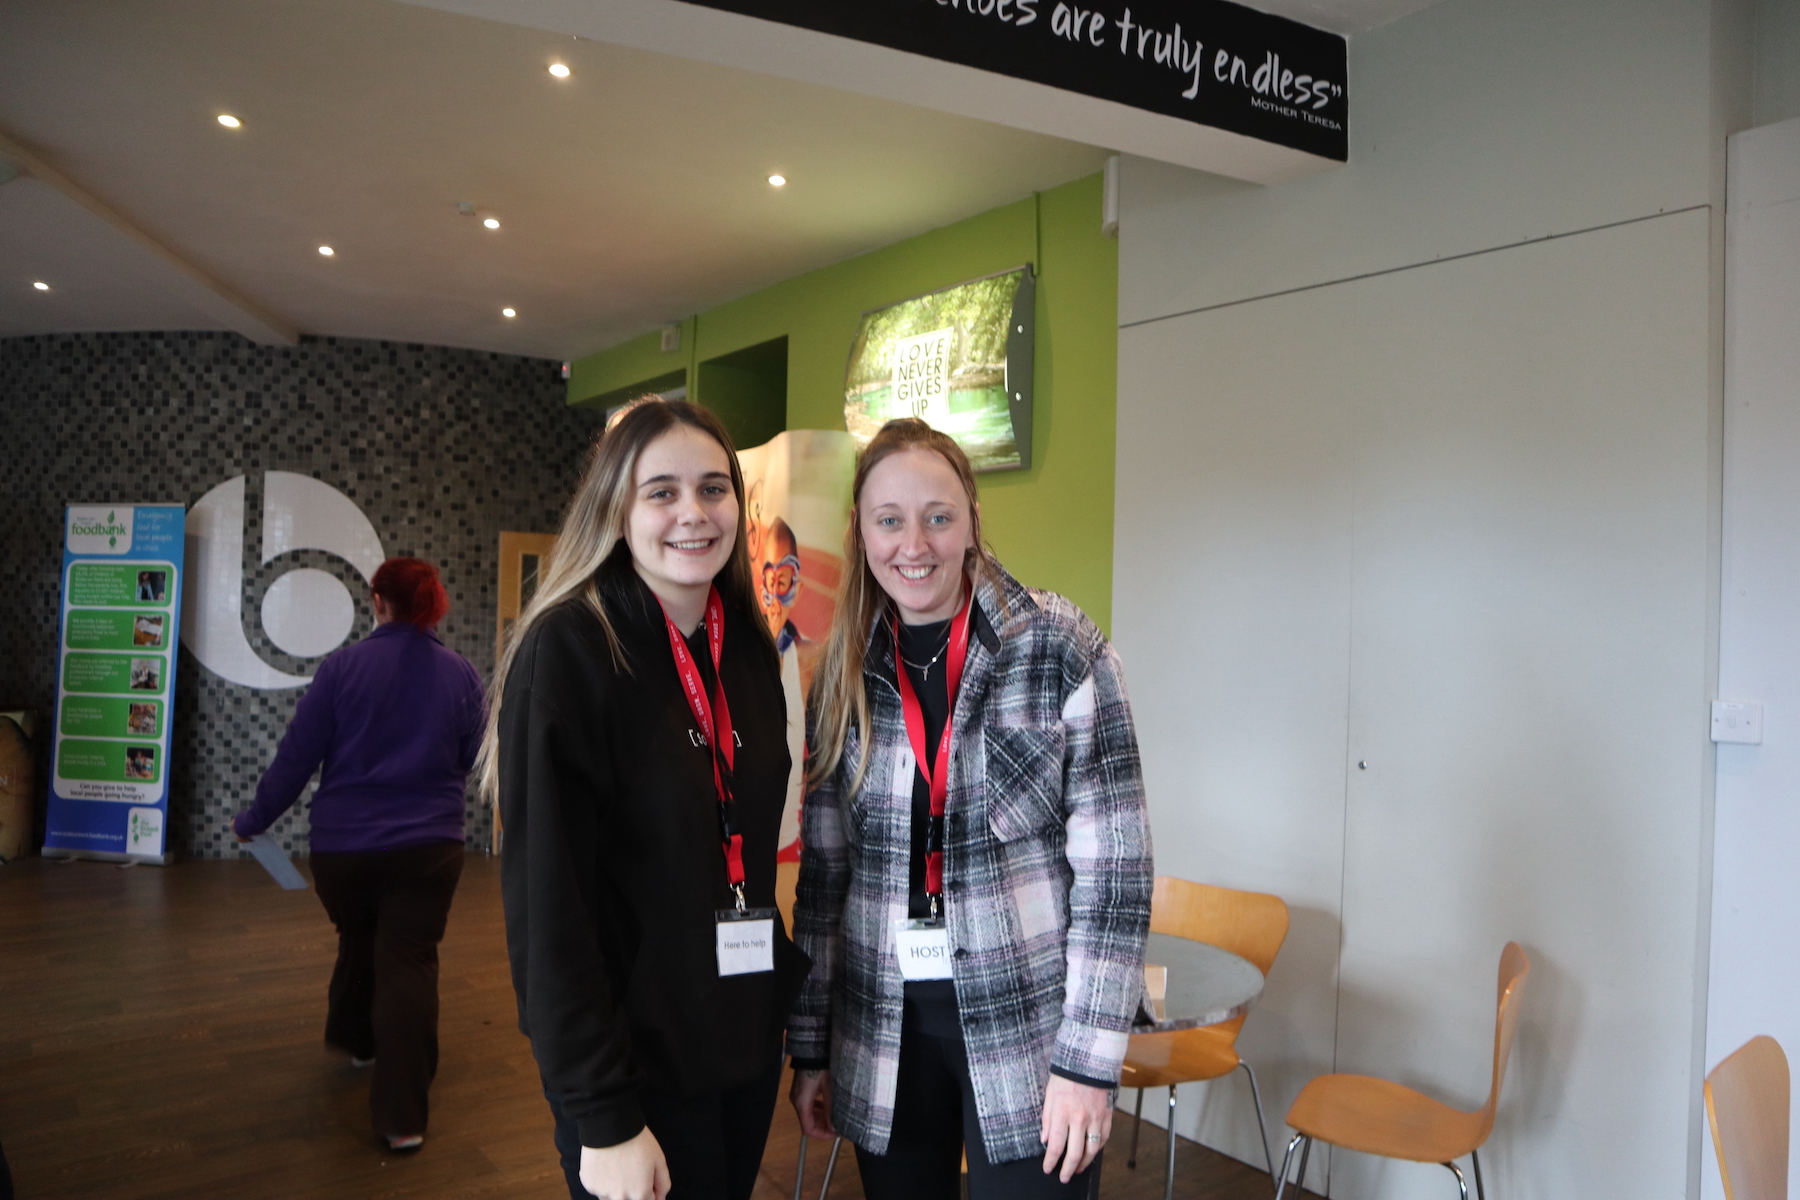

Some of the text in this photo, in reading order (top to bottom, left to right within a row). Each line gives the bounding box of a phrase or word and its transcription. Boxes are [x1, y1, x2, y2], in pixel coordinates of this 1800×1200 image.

[1051, 2, 1105, 46] are
[1115, 9, 1203, 99] truly
[901, 338, 945, 363] LOVE
[898, 357, 942, 381] NEVER
[897, 377, 941, 400] GIVES
[911, 399, 928, 418] UP
[71, 522, 126, 536] foodbank
[84, 790, 103, 798] people
[104, 791, 121, 799] going
[103, 784, 115, 792] give
[124, 785, 136, 793] help
[724, 939, 766, 950] Here to help
[910, 945, 946, 959] HOST
